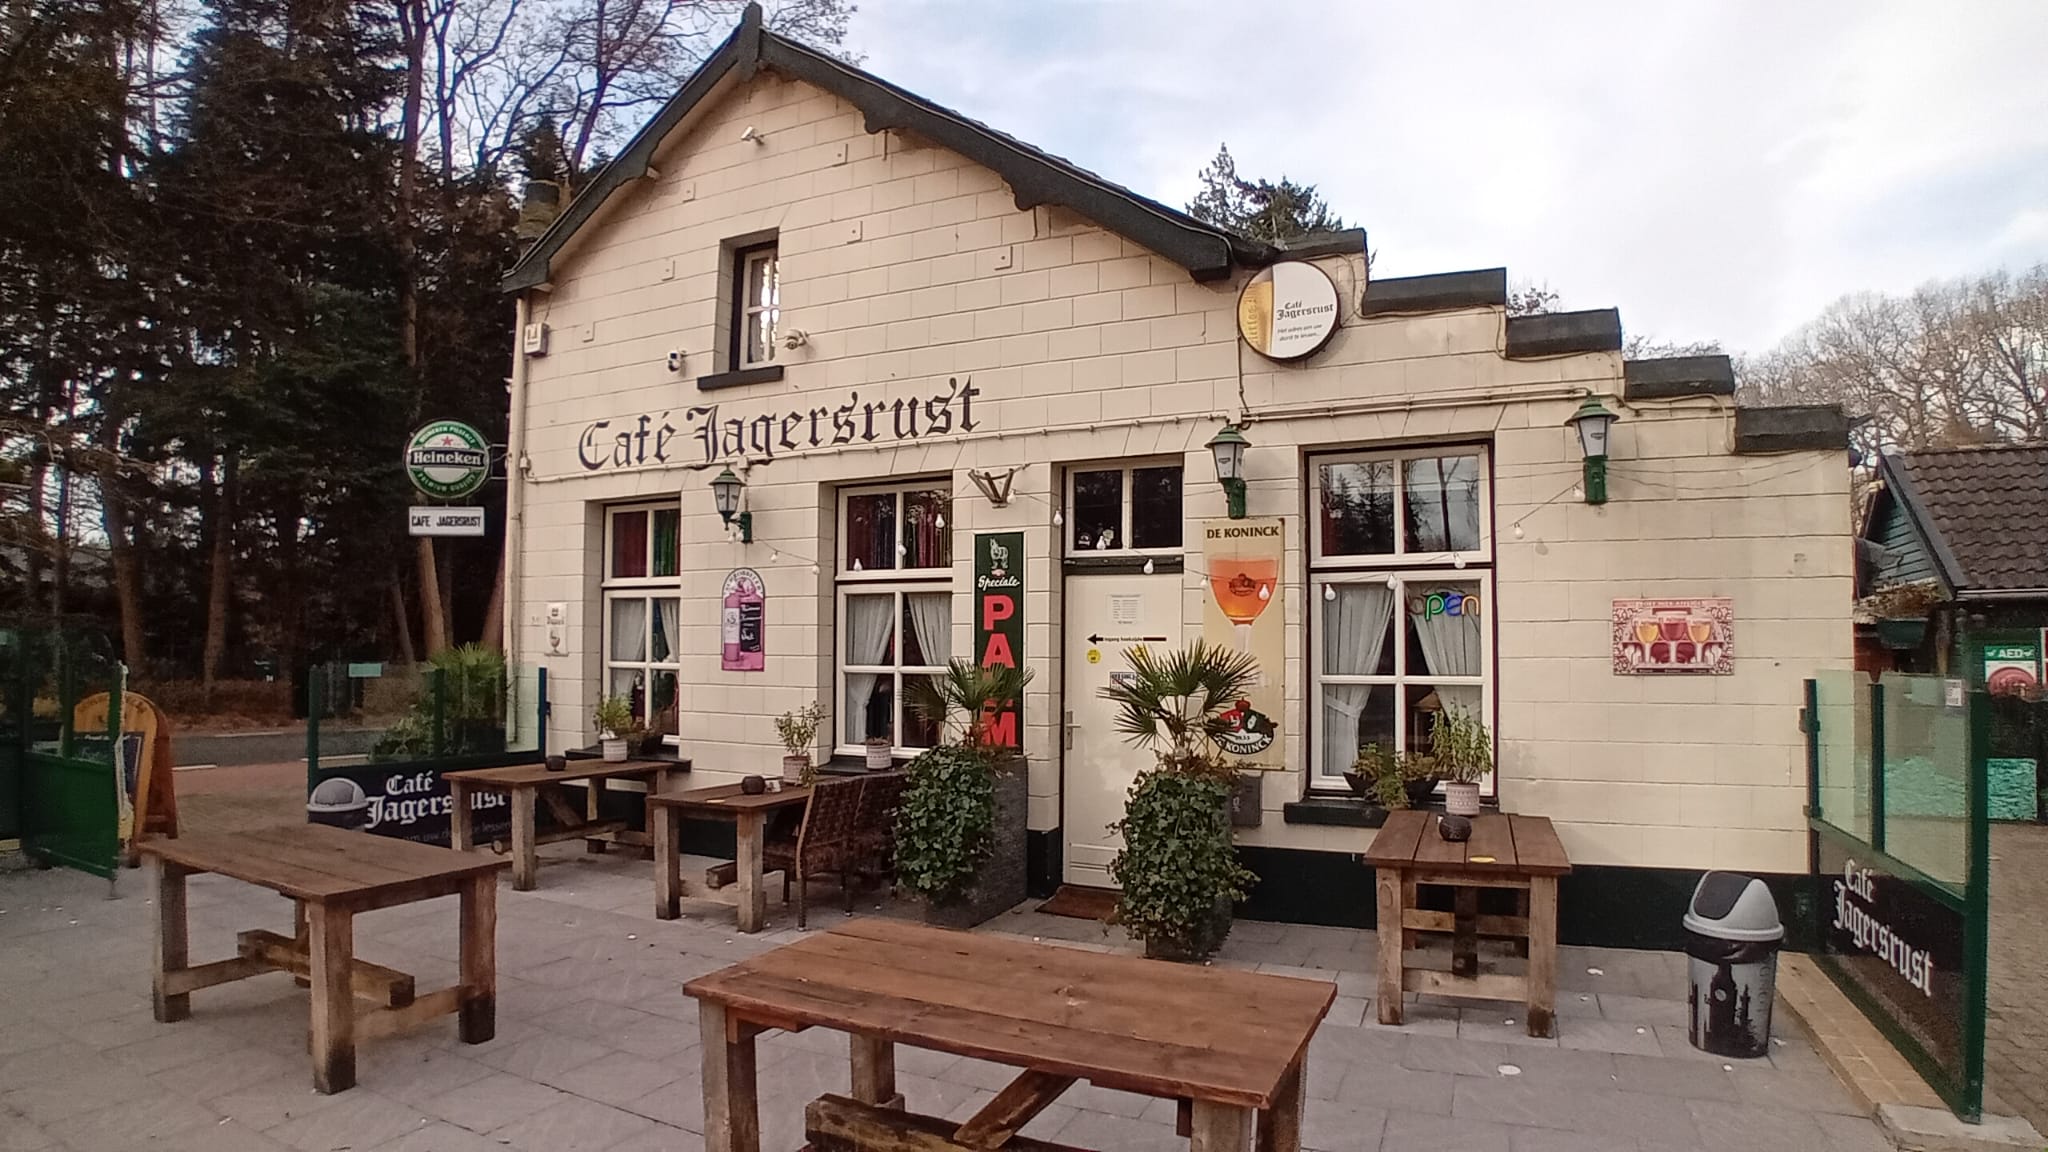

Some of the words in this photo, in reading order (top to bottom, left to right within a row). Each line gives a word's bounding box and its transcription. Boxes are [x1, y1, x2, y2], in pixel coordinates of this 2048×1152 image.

[1276, 304, 1334, 320] Jagersrust
[577, 410, 678, 471] Café
[686, 373, 981, 471] Jagersrust
[413, 451, 482, 465] Heineken
[411, 515, 431, 527] CAFE
[436, 515, 481, 527] JAGERSRUST
[1206, 528, 1222, 539] DE
[1224, 525, 1279, 538] KONINCK
[978, 575, 1020, 591] Speciale
[1999, 649, 2023, 659] AED
[1225, 733, 1272, 754] KONINCK
[386, 770, 434, 795] Café
[364, 790, 506, 829] Jagersust
[1844, 858, 1875, 904] Café
[1833, 879, 1934, 998] Jagersrust
